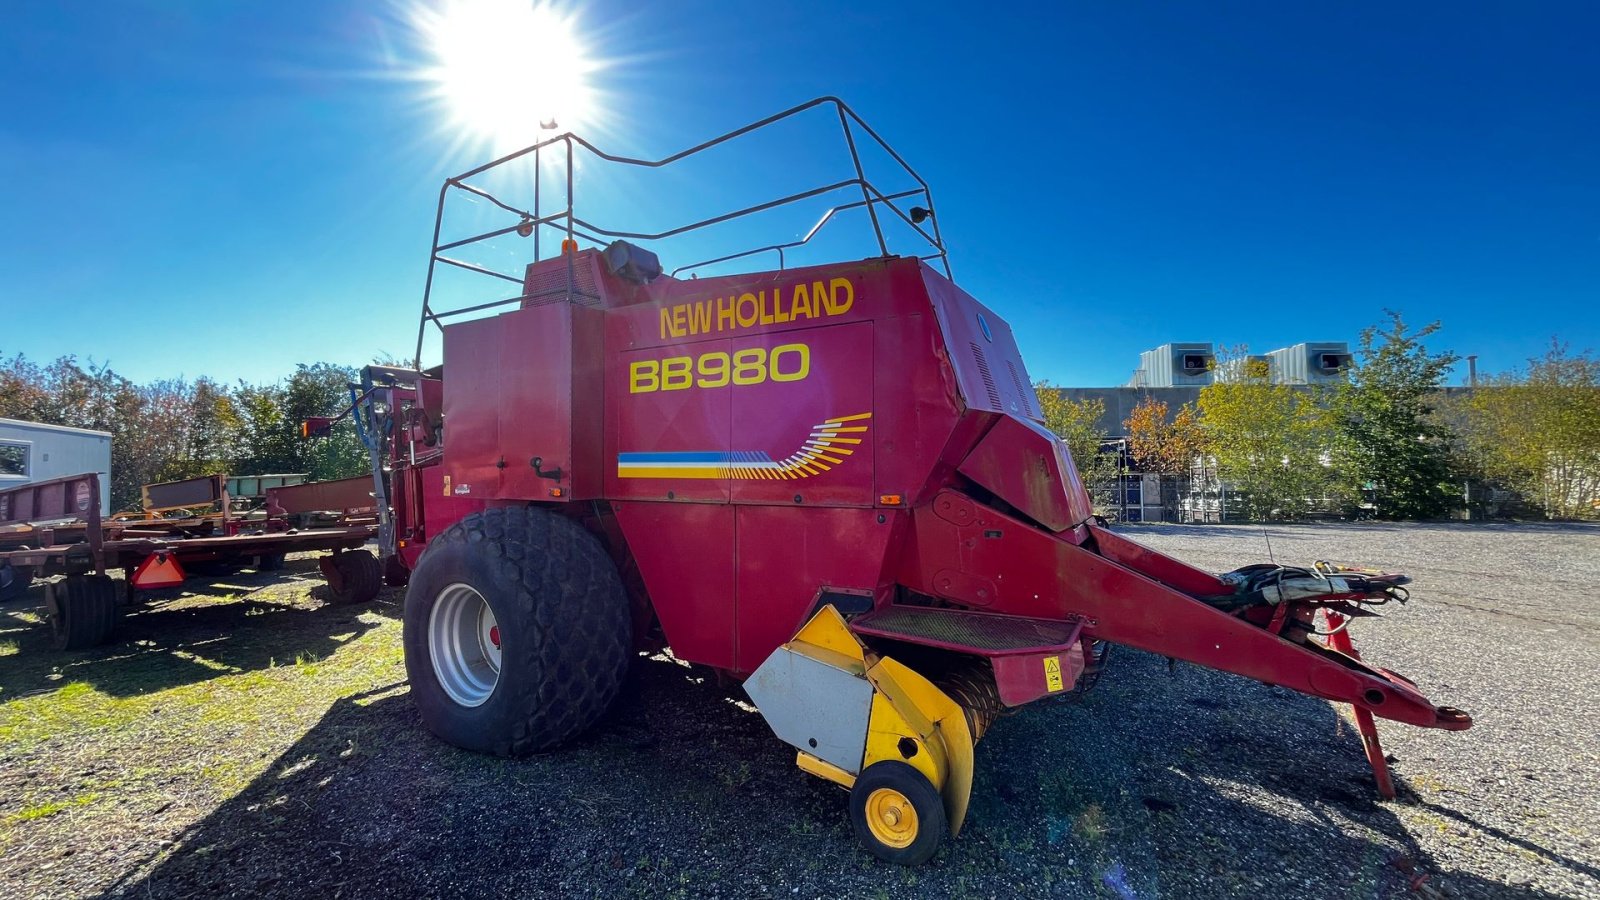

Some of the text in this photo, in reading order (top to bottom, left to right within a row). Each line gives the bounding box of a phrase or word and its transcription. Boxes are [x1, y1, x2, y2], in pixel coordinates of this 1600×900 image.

[660, 277, 854, 339] NEW HOLLAND
[629, 343, 810, 393] BB980
